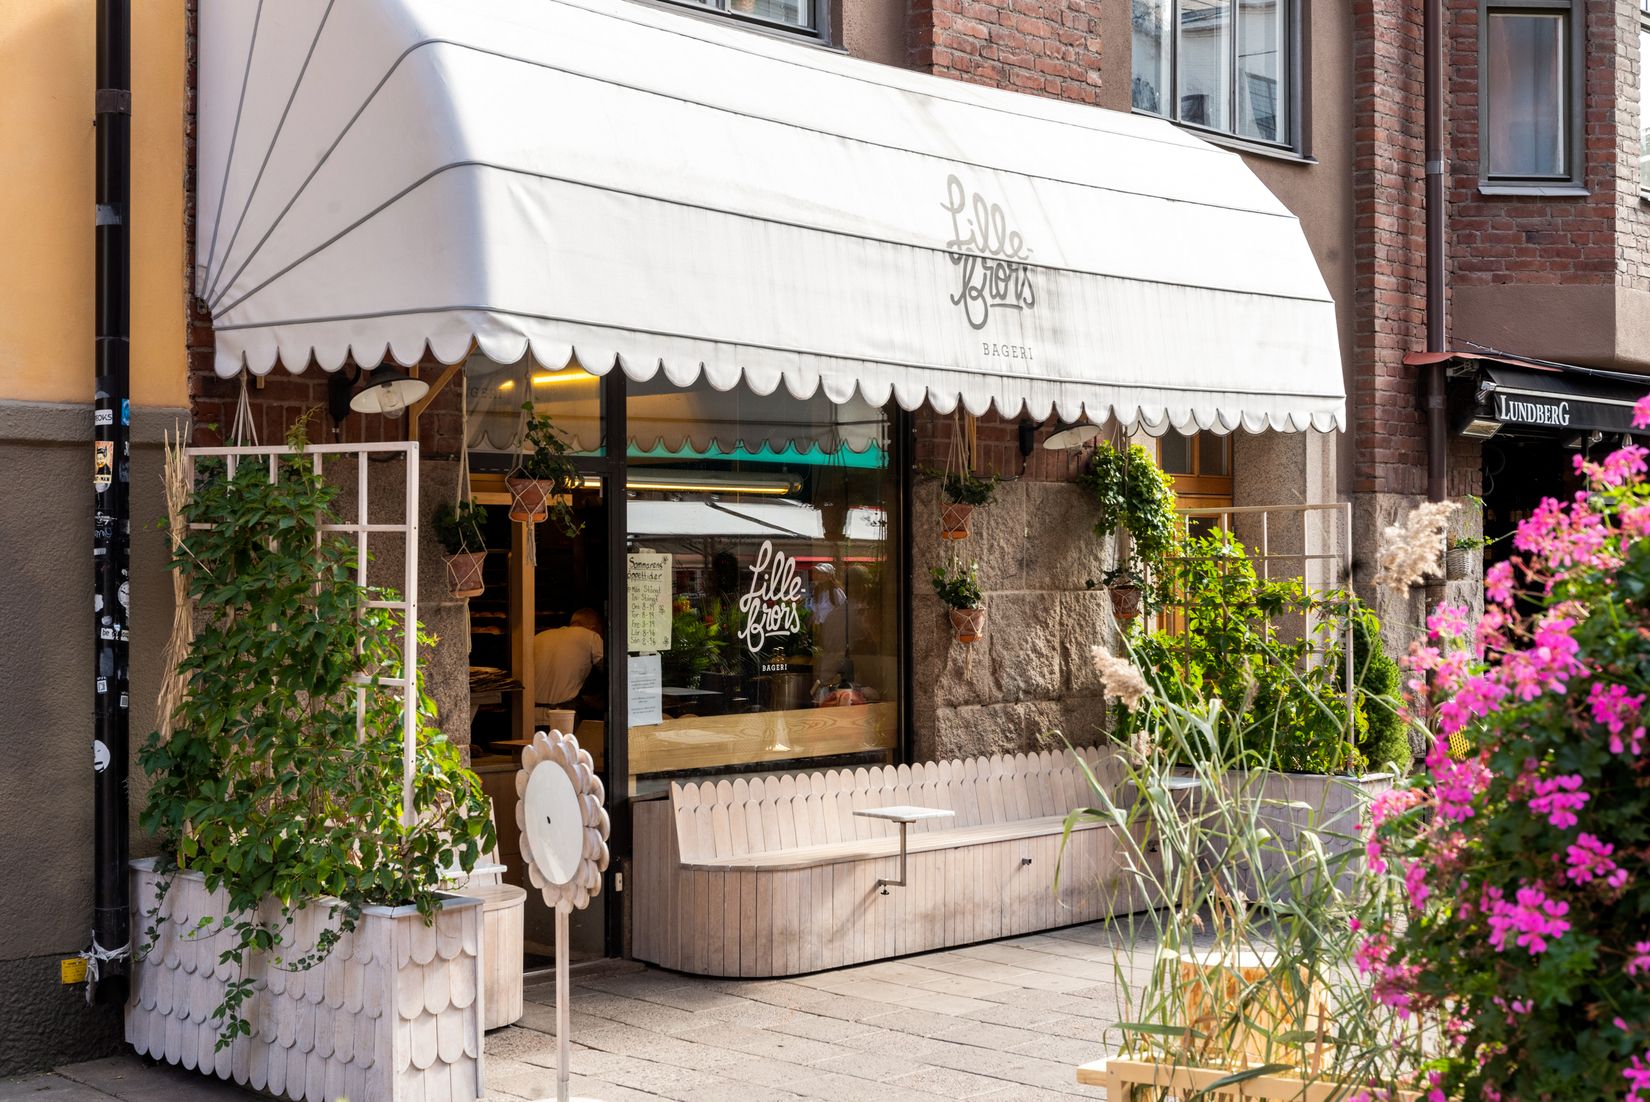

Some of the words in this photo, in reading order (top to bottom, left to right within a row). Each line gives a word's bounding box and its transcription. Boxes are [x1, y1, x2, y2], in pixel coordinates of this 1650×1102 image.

[982, 342, 1034, 361] BAGERI
[1500, 395, 1570, 426] LUNDBERG
[762, 663, 788, 672] BAGERI
